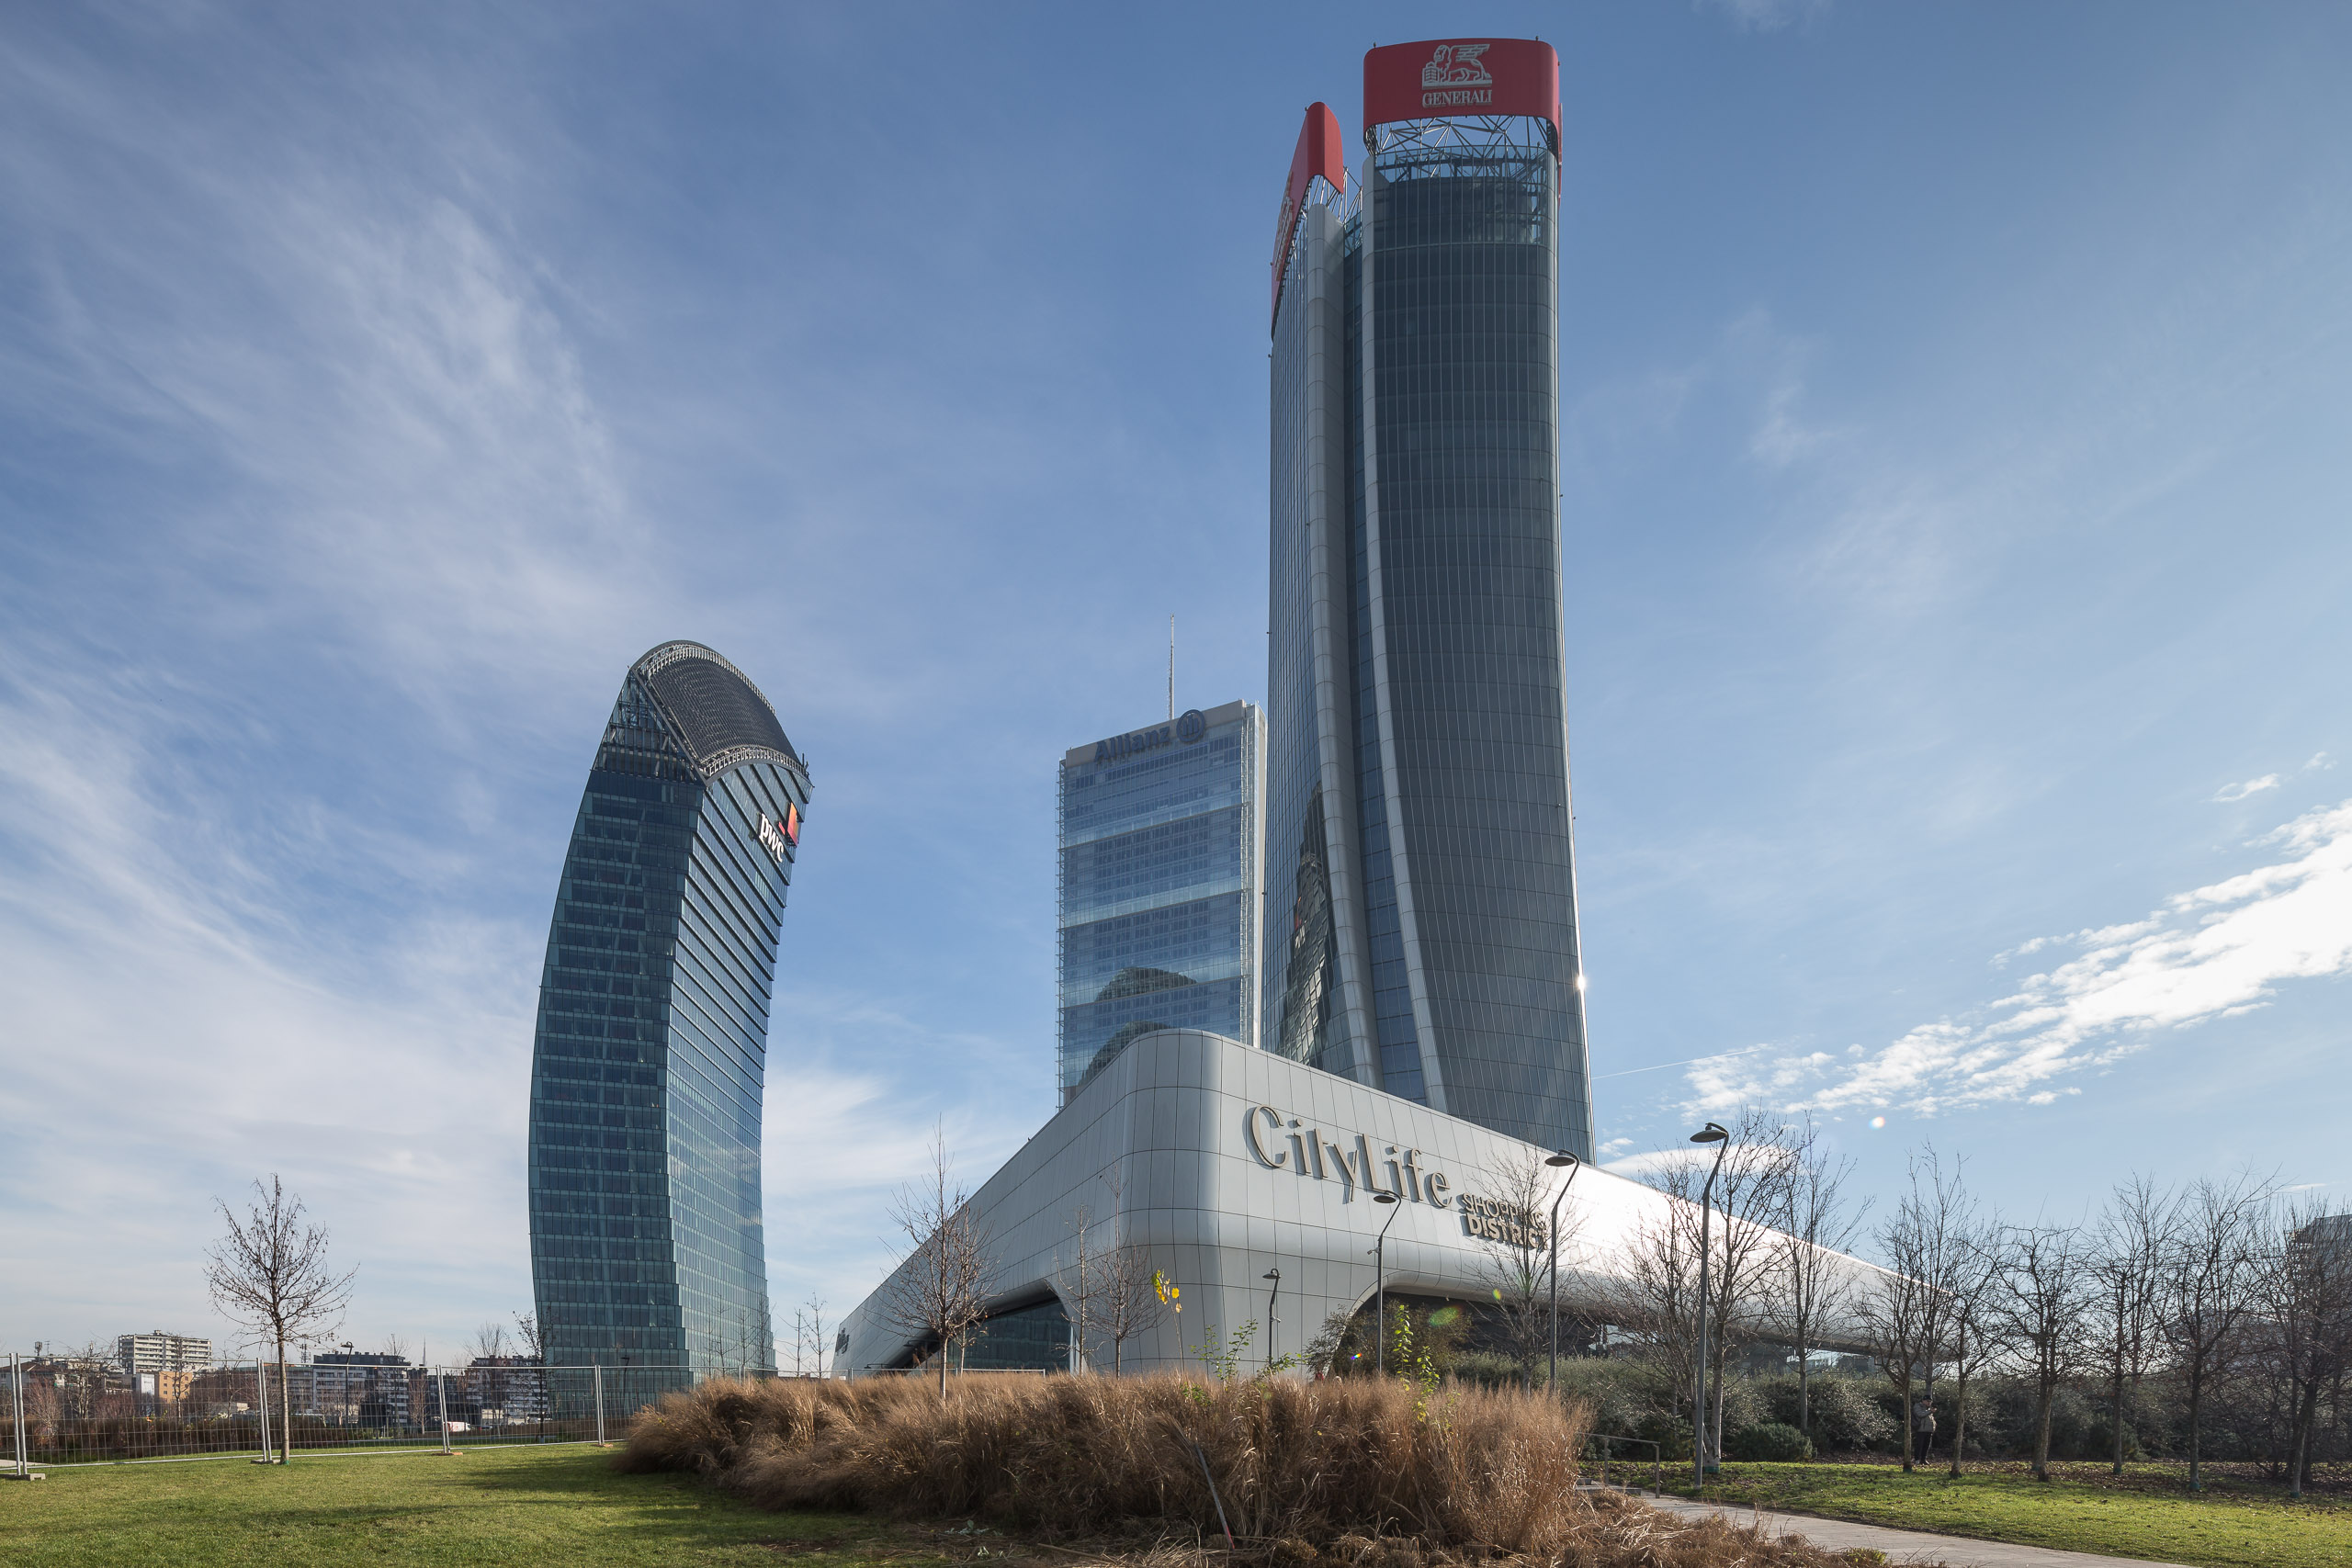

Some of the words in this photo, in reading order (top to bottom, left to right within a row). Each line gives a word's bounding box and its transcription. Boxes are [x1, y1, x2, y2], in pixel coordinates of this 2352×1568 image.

[1422, 89, 1492, 107] GENERALI
[1094, 727, 1170, 762] Allianz
[759, 813, 784, 863] pwc
[1250, 1105, 1453, 1208] CityLife
[1463, 1192, 1546, 1230] SHOPPNG
